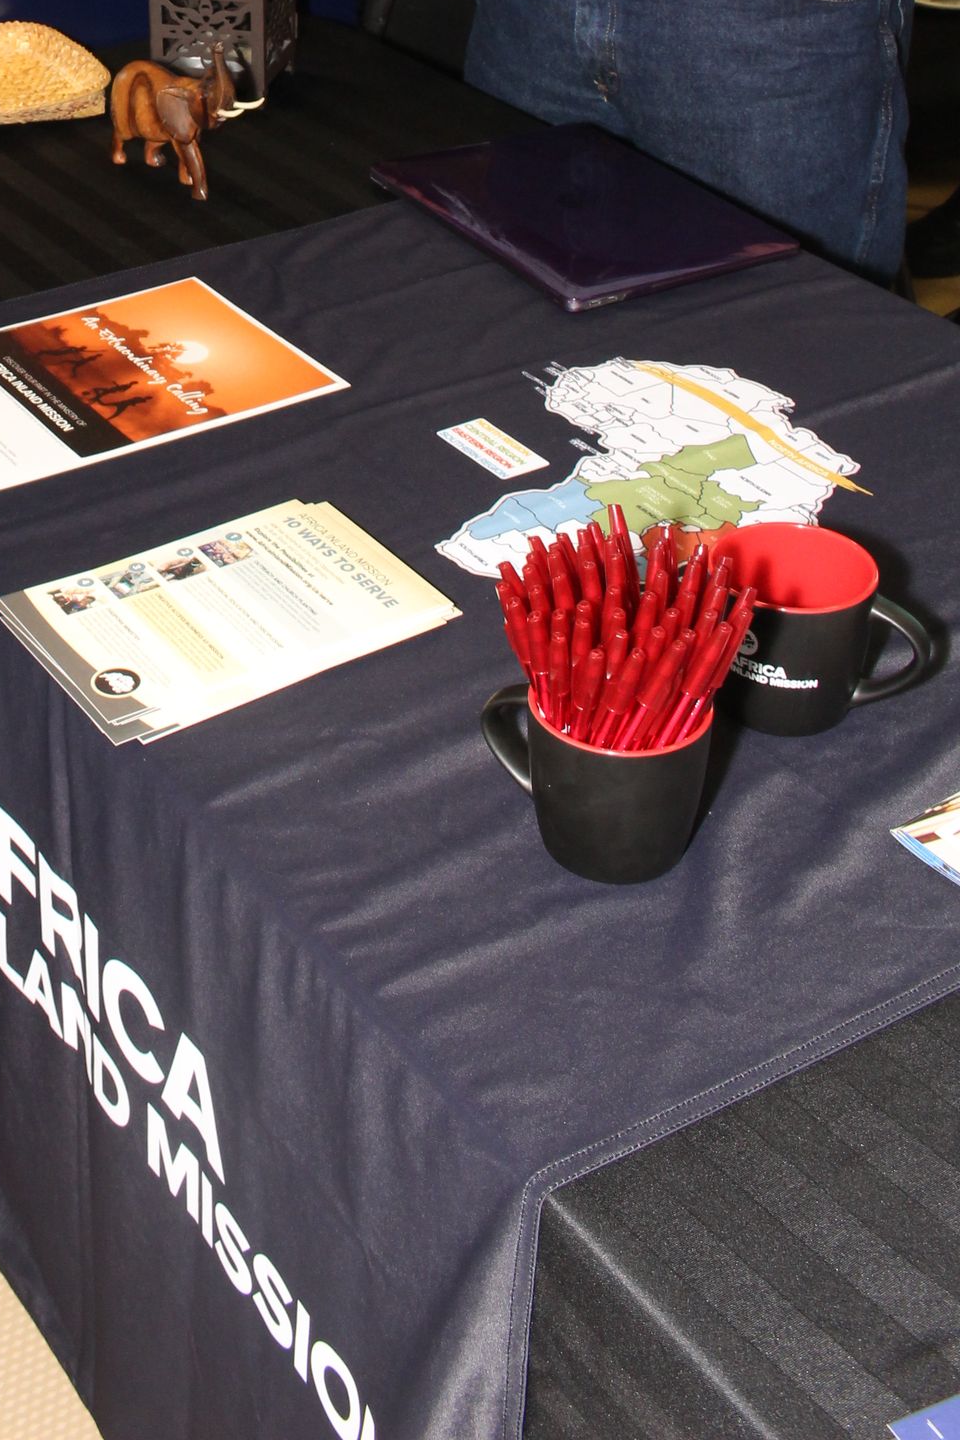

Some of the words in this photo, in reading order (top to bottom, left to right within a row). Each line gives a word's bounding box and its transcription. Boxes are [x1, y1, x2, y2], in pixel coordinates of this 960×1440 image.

[81, 316, 100, 331] An
[99, 327, 167, 385] Extraordinary
[166, 383, 209, 416] Calling
[12, 378, 43, 405] INLAND
[39, 401, 74, 432] MISSION
[442, 431, 479, 458] SOUTHERN
[480, 458, 506, 477] REGION
[452, 427, 484, 449] EASTERN
[484, 448, 512, 469] REGION
[464, 424, 497, 446] CENTRAL
[498, 445, 525, 464] REGION
[502, 435, 530, 456] REGION
[283, 517, 302, 528] 10
[297, 528, 336, 557] WAYS
[333, 557, 355, 572] TO
[352, 573, 399, 608] SERVE
[298, 513, 328, 534] AFRICA
[329, 536, 357, 558] INLAND
[356, 558, 392, 585] MISSION
[733, 655, 787, 679] AFRICA
[769, 677, 819, 689] MISSION
